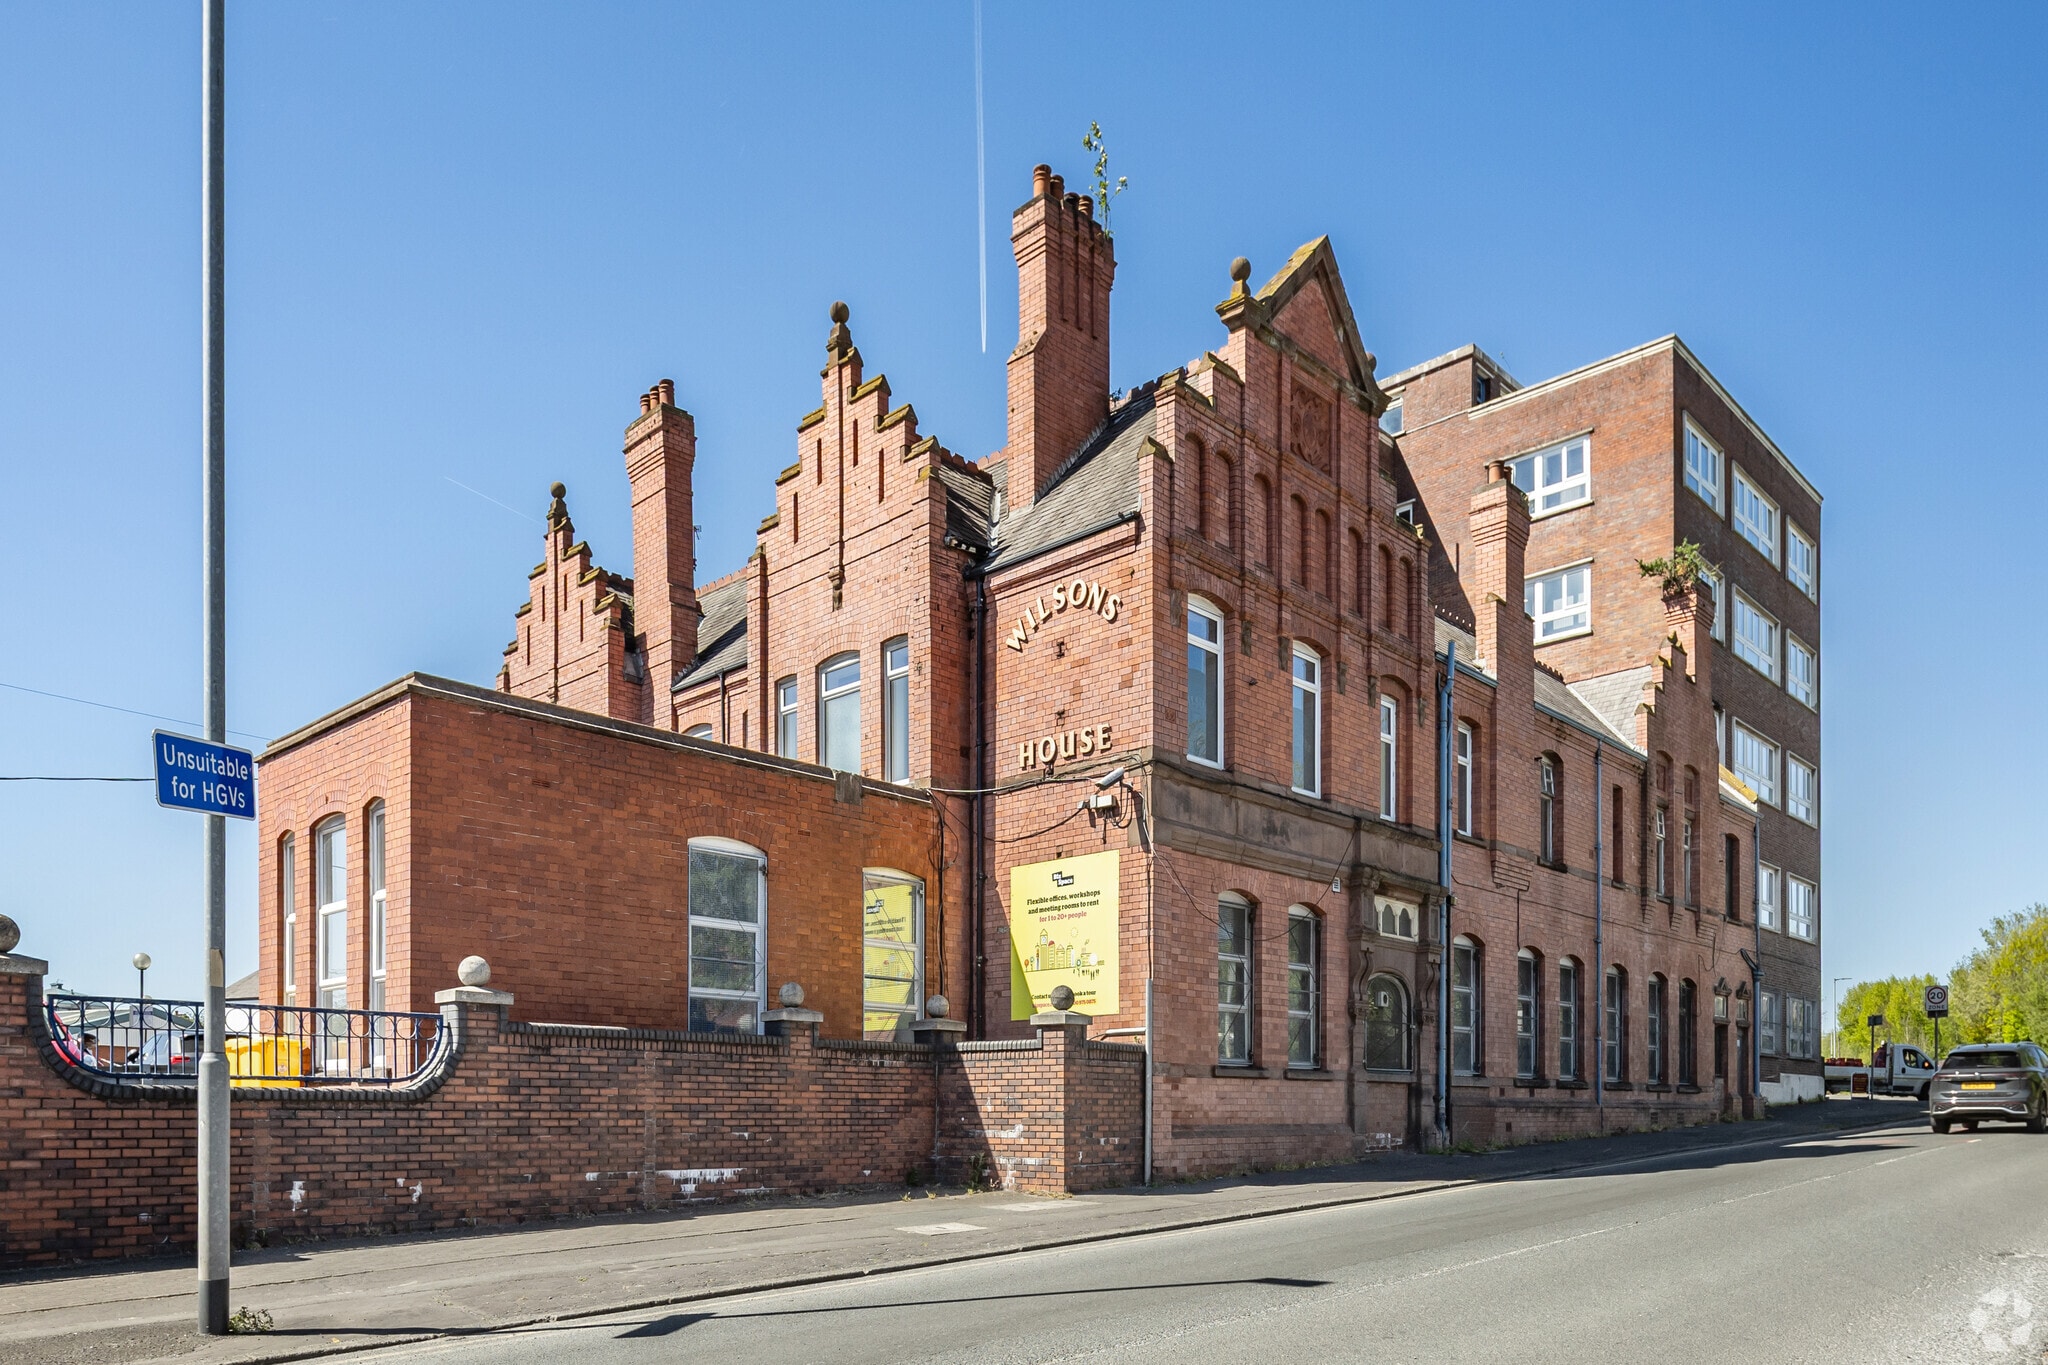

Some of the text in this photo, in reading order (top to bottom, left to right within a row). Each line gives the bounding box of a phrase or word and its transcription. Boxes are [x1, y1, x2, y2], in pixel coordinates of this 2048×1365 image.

[1019, 723, 1112, 768] HOUSE
[163, 742, 248, 781] Unsuitable
[171, 775, 246, 809] for HGVs
[1027, 897, 1048, 905] Flexible
[1069, 890, 1100, 899] workshops
[1039, 904, 1061, 912] meeting
[1062, 902, 1079, 910] rooms
[1068, 911, 1087, 920] people
[1930, 991, 1943, 999] 20
